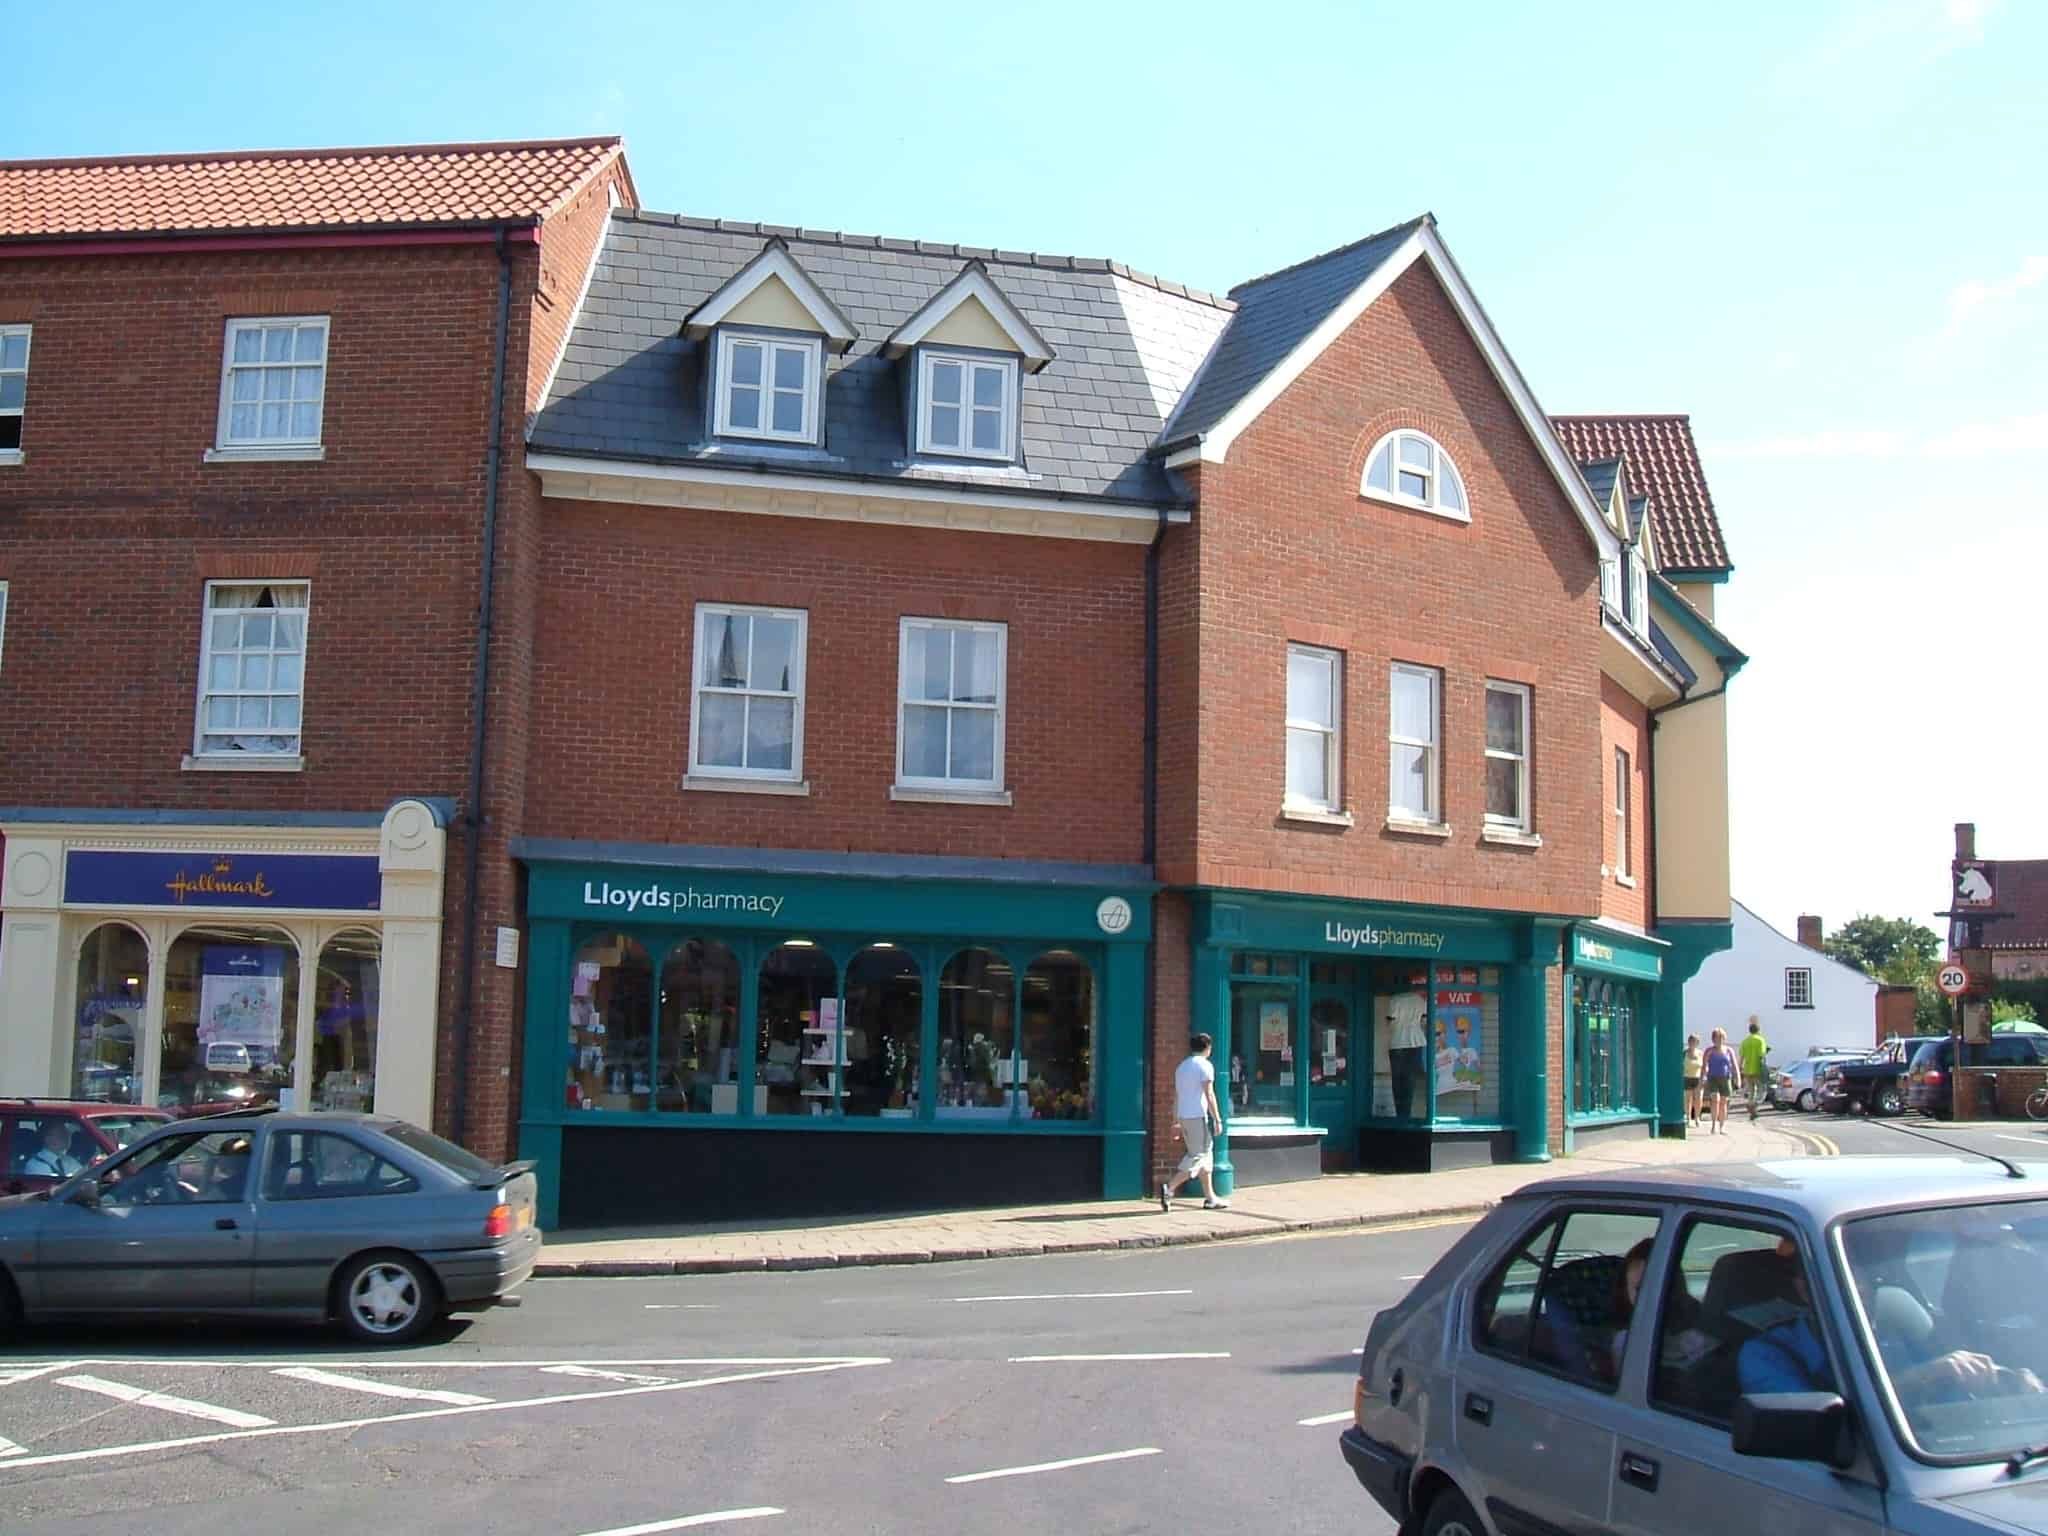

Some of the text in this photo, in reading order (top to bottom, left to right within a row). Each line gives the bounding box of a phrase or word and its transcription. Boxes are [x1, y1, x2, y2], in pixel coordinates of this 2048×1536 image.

[165, 870, 273, 903] Hallmark
[584, 881, 784, 918] Lloydspharmacy
[1325, 921, 1445, 953] Lloydspharmacy
[1942, 972, 1964, 986] 20
[1448, 992, 1472, 1004] VAT
